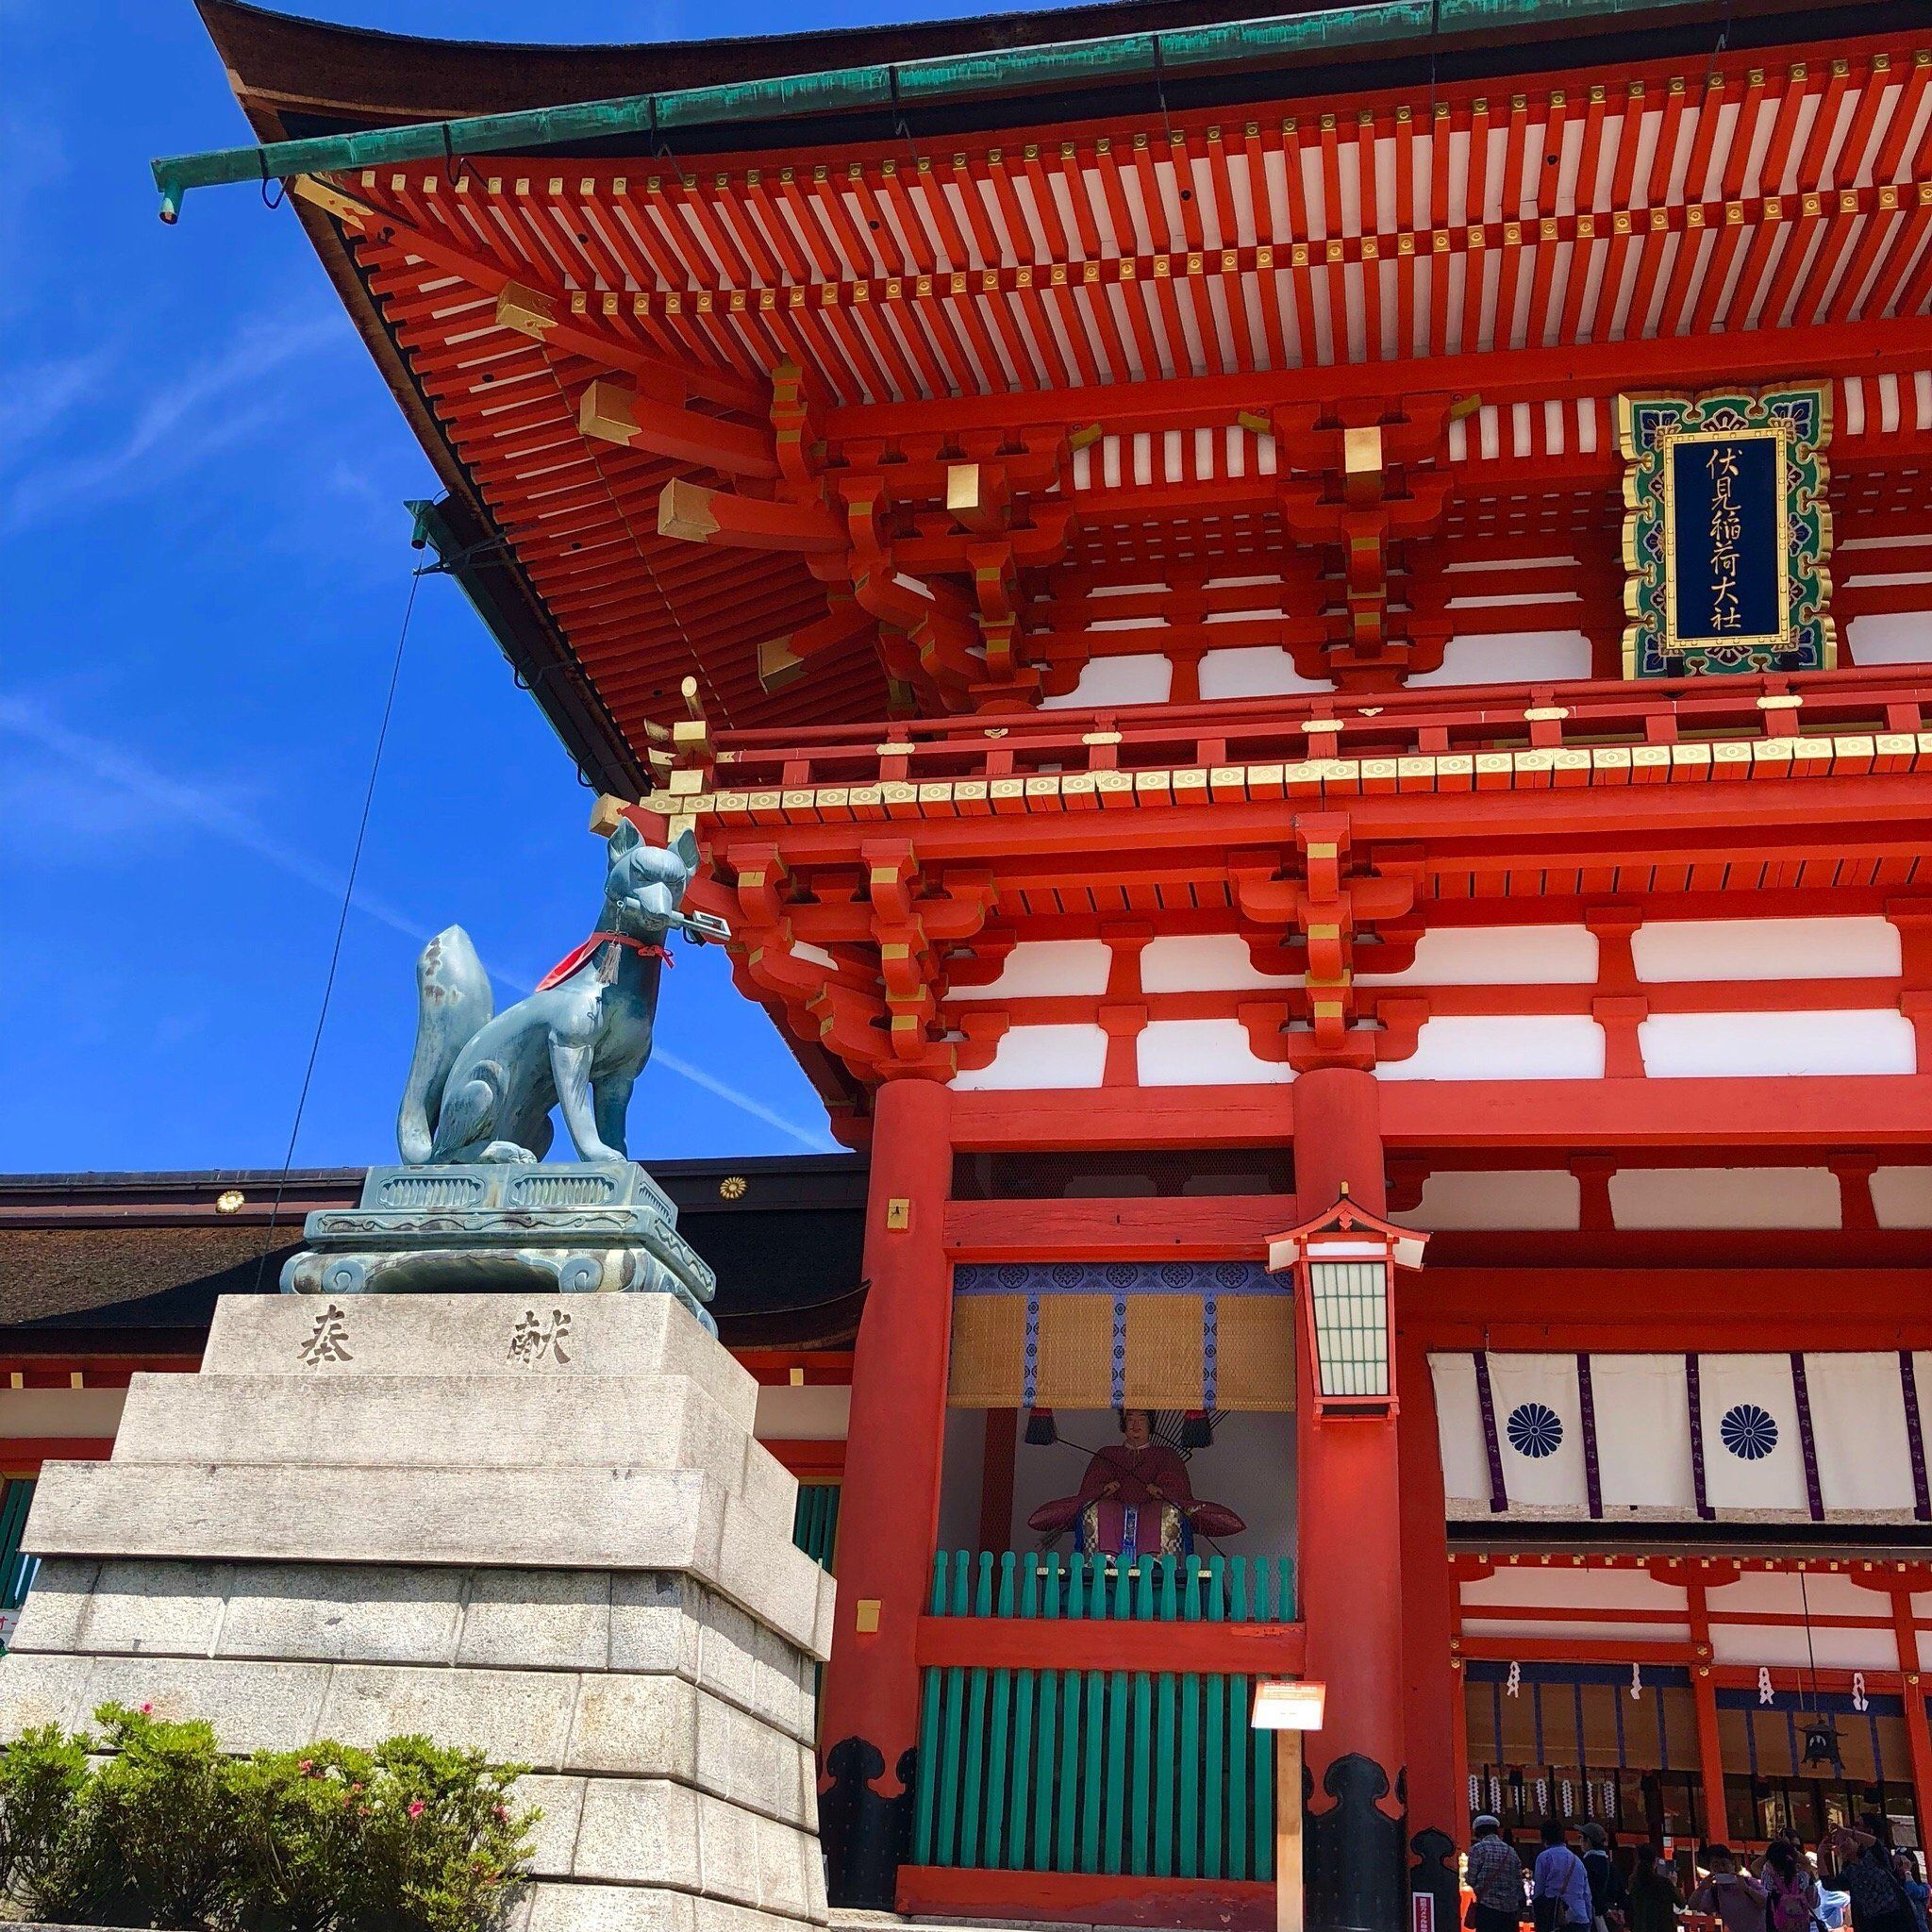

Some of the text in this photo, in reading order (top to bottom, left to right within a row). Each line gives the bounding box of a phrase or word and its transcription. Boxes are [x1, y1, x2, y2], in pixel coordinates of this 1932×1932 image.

[1706, 448, 1742, 631] 伏見稲荷大社
